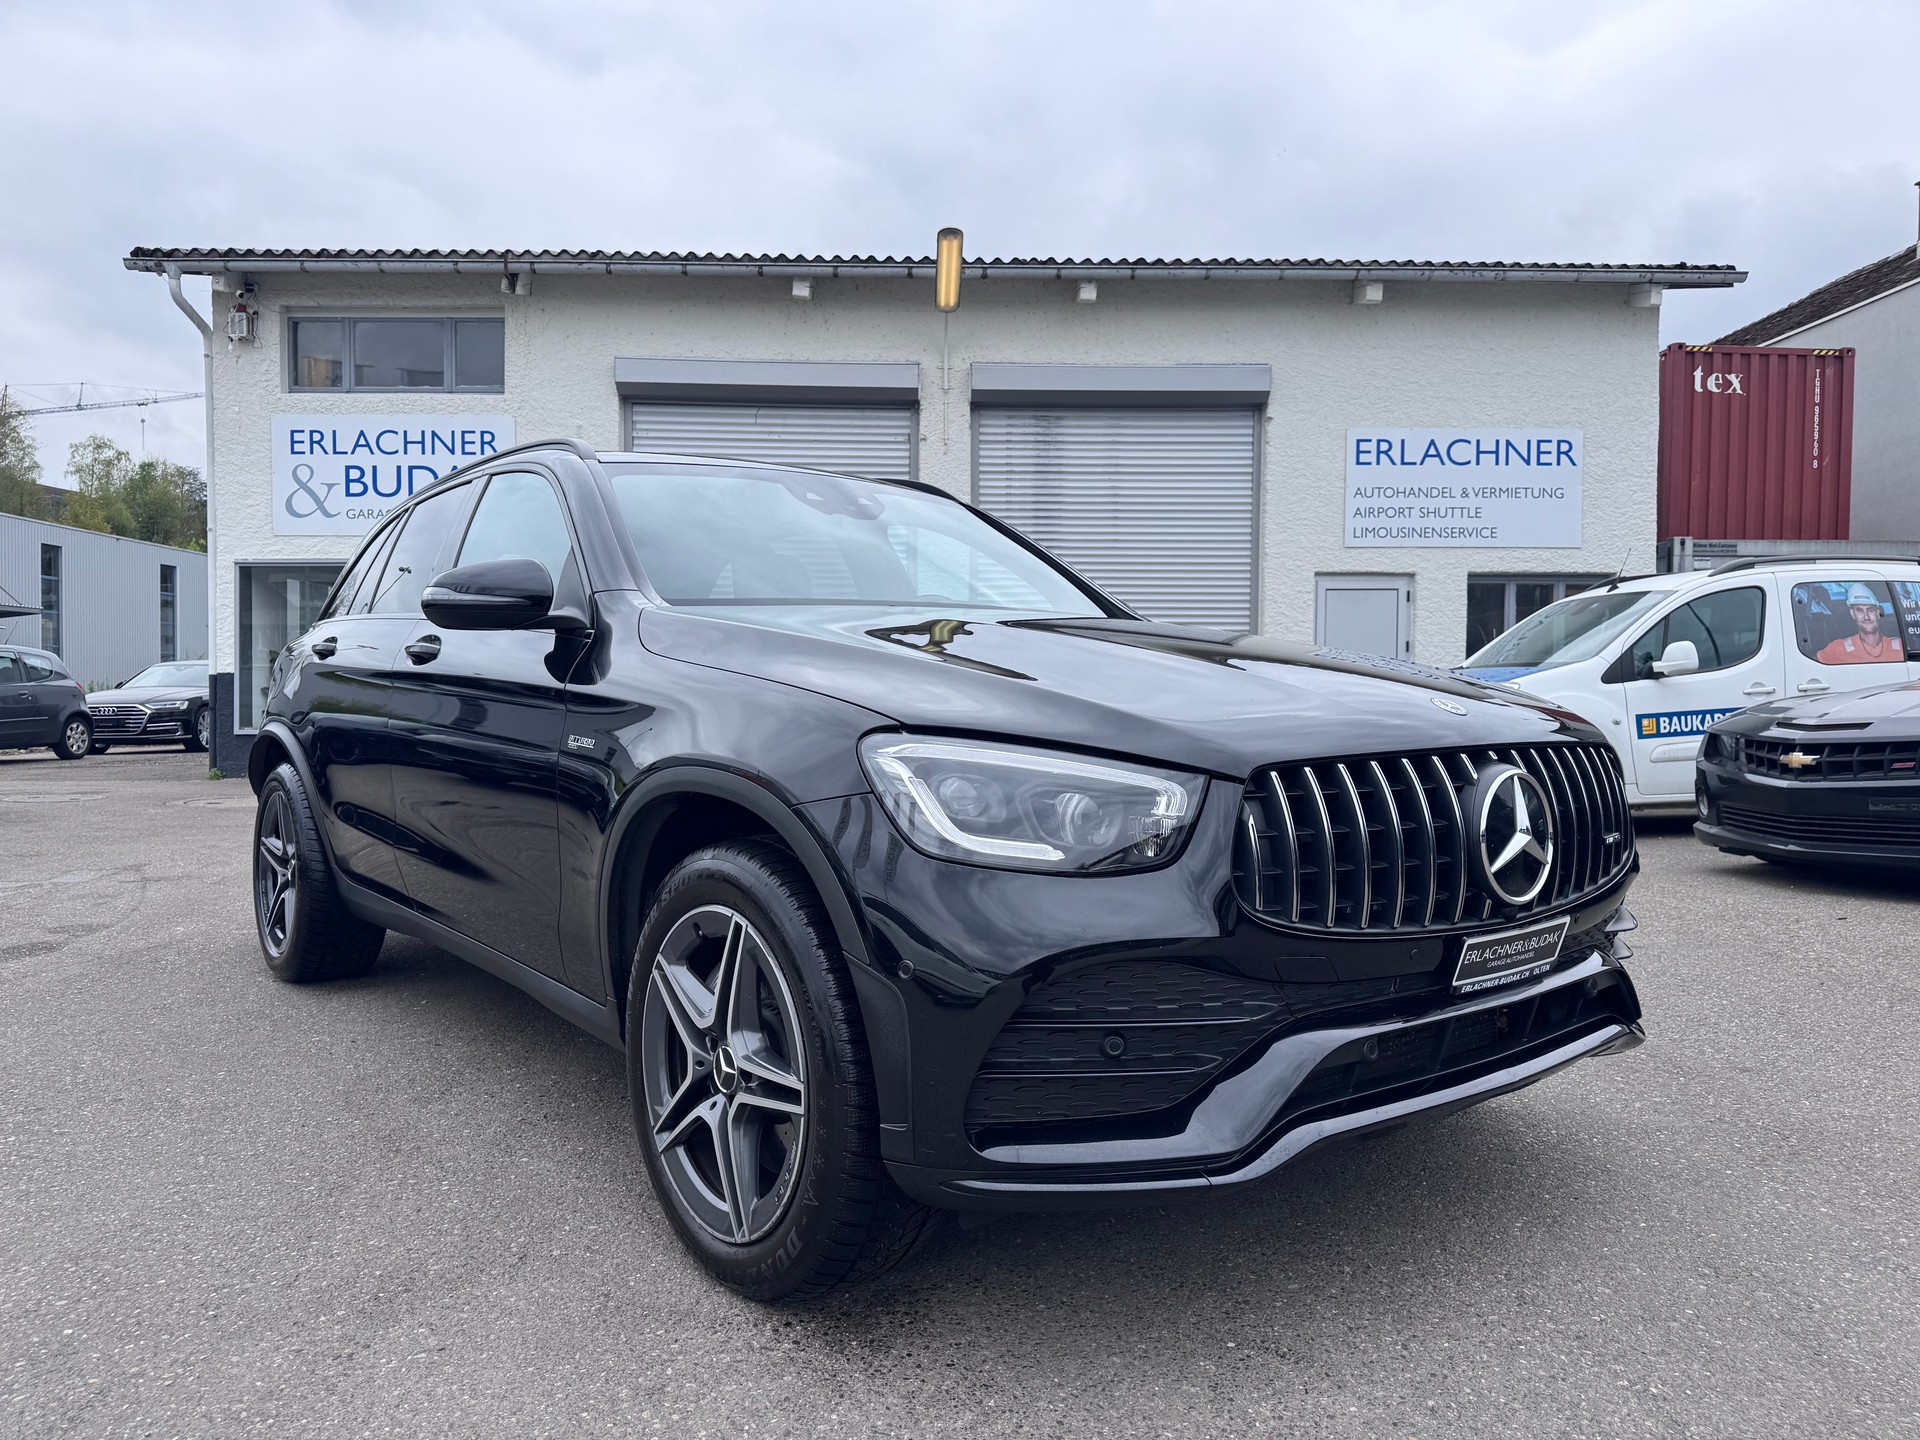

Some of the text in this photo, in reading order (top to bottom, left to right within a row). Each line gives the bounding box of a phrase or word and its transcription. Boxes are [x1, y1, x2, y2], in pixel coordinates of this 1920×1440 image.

[1693, 365, 1743, 394] tex
[290, 429, 498, 455] ERLACHNER
[1355, 438, 1577, 466] ERLACHNER
[285, 463, 458, 518] & BUD
[1353, 486, 1565, 499] AUTOHANDEL & VERMIETUNG
[1353, 506, 1482, 519] AIRPORT SHUTTLE
[1353, 526, 1498, 539] LIMOUSINENSERVICE
[1660, 712, 1731, 734] BAUKA
[1464, 930, 1561, 964] ERLACHNER&BUDAK
[1533, 964, 1550, 975] OLTEN
